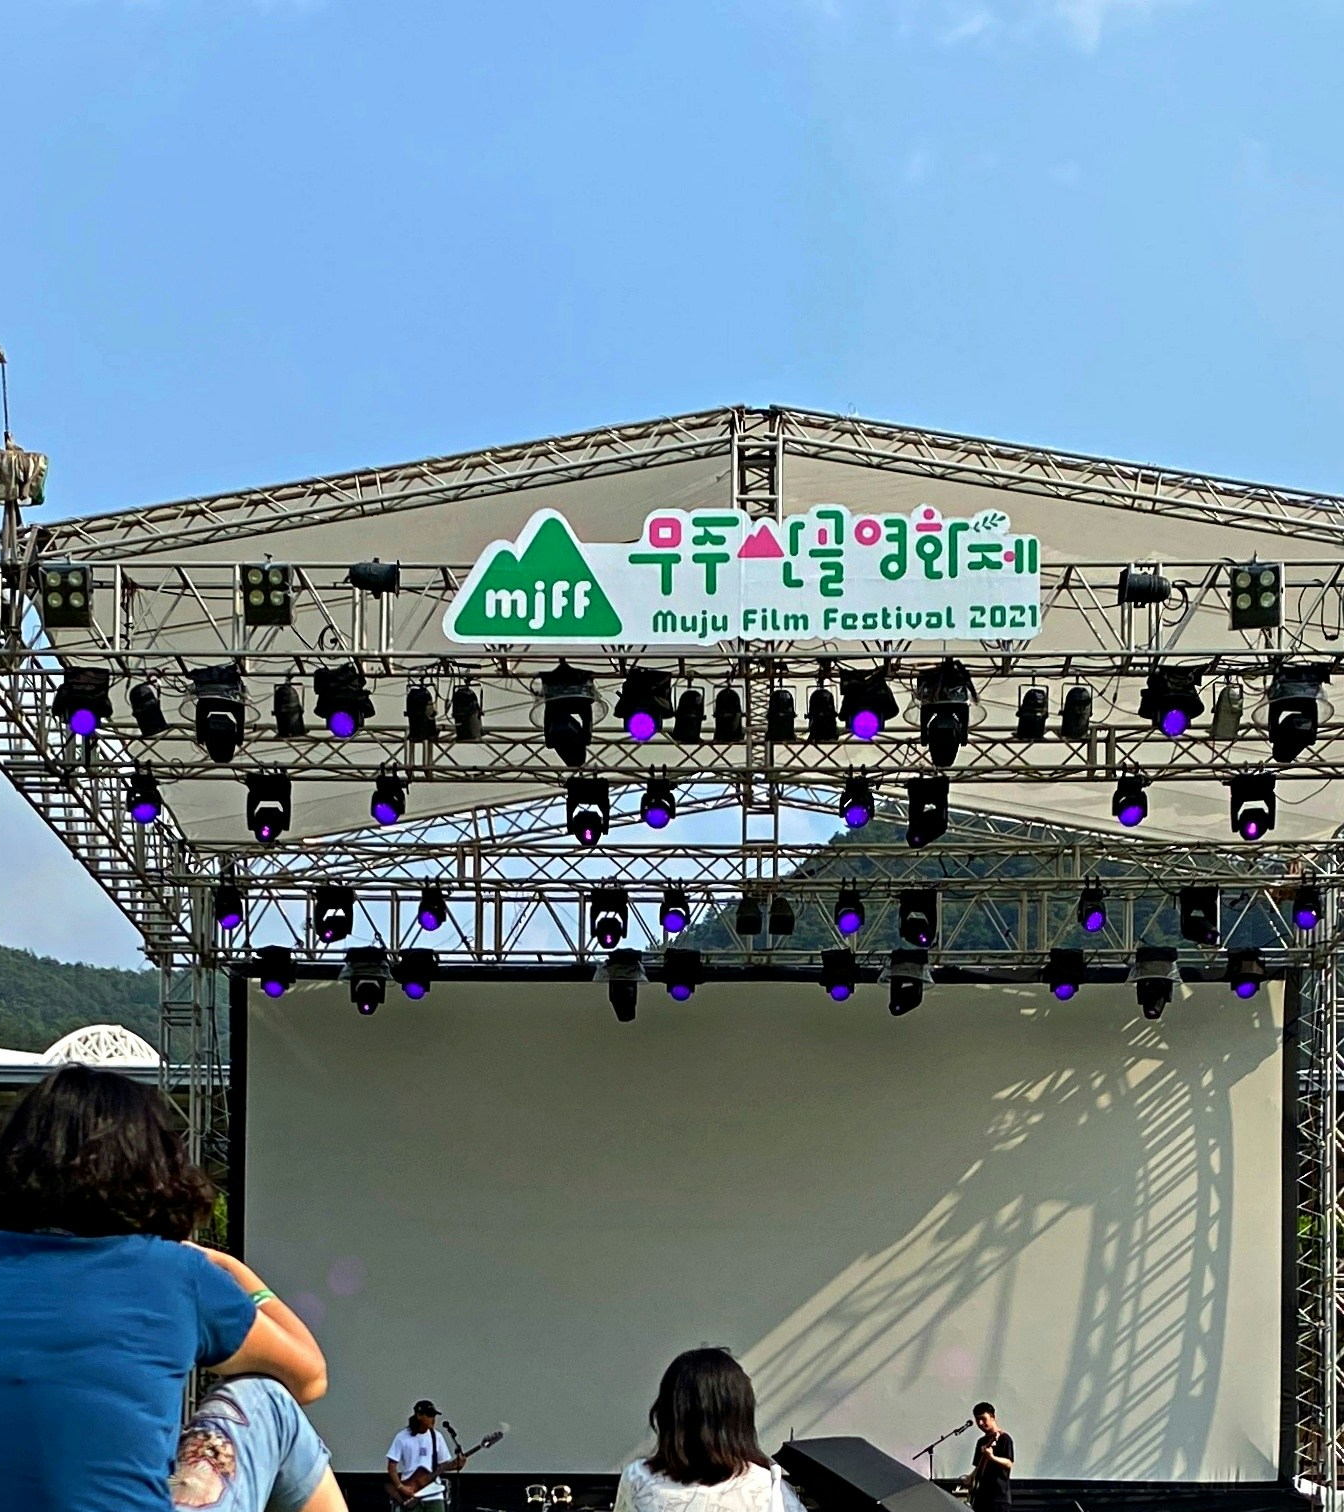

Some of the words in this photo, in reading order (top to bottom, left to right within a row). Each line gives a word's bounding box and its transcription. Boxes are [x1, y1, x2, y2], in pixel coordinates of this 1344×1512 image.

[629, 508, 1038, 597] 무주산골영화제
[485, 580, 592, 630] mjff
[653, 609, 728, 638] Muju
[742, 608, 809, 631] Film
[823, 605, 956, 630] Festival
[969, 604, 1038, 628] 2021
